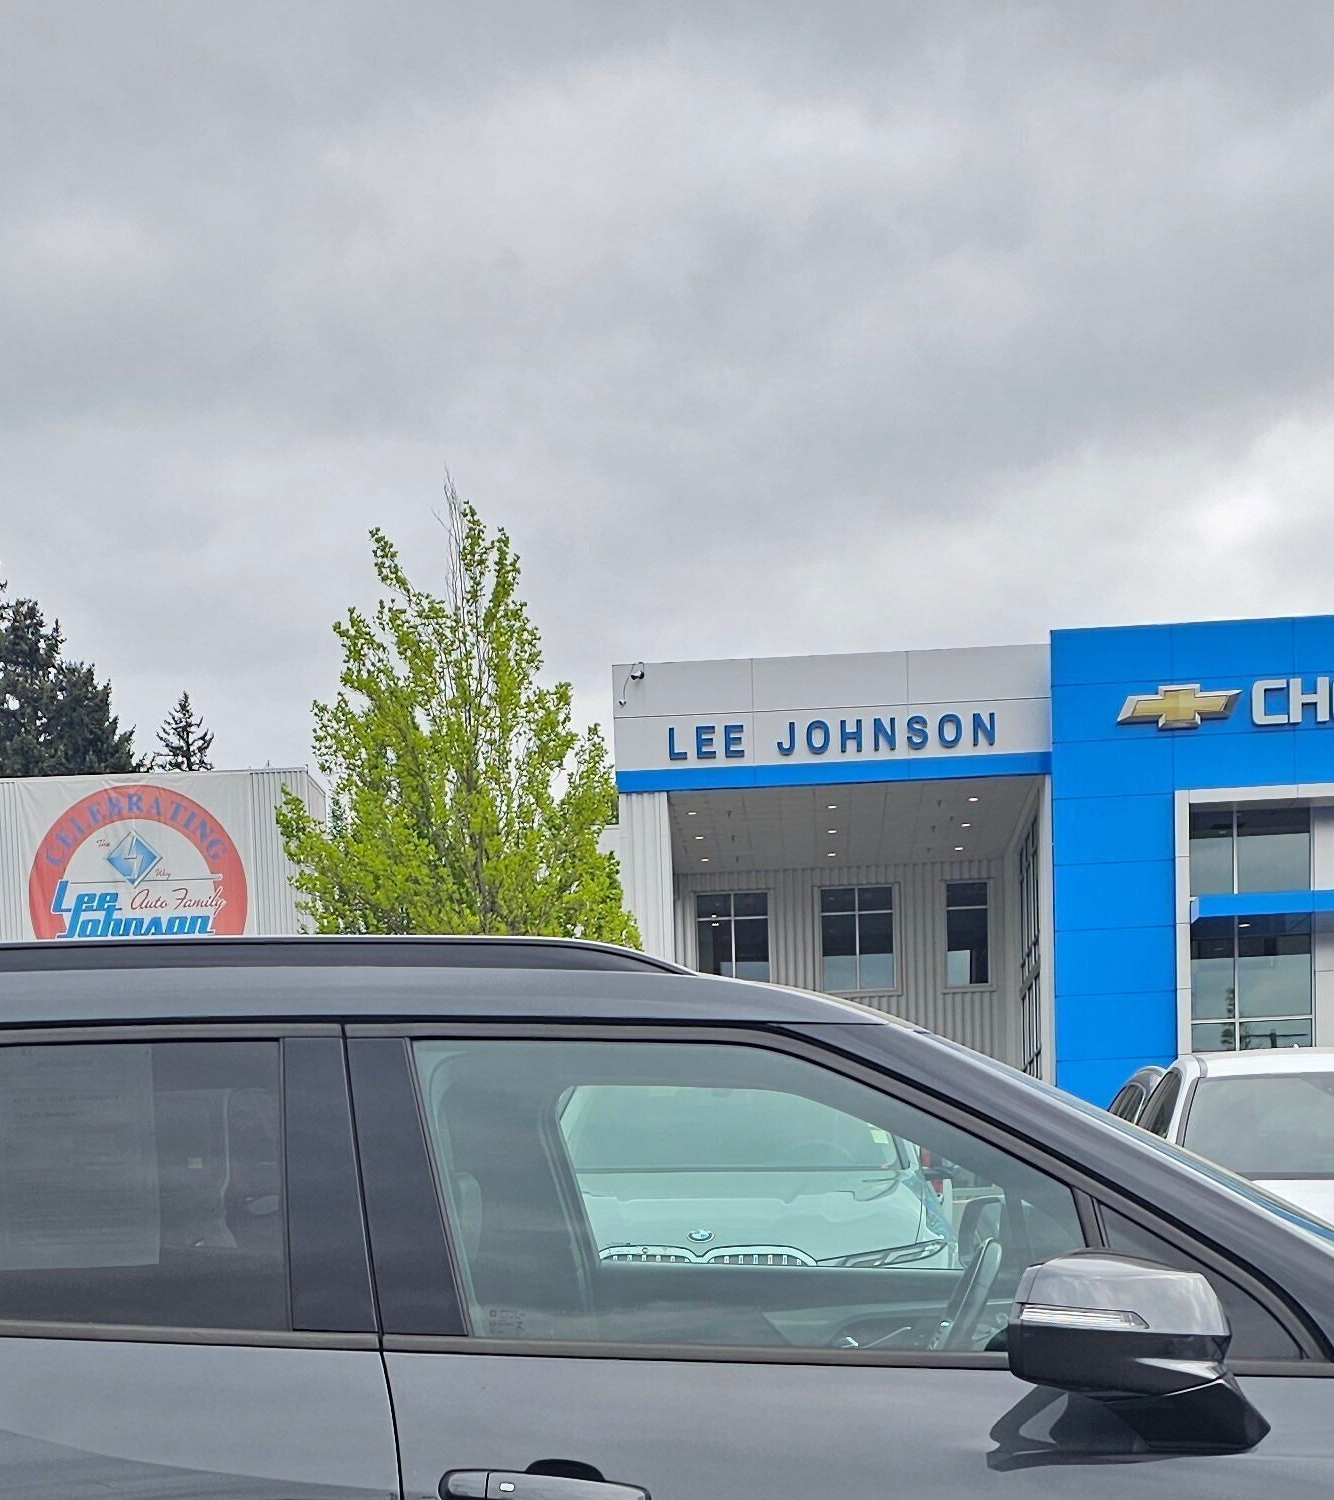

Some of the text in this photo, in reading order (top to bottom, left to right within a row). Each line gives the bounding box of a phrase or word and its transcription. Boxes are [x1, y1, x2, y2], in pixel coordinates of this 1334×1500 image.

[668, 712, 997, 761] LEE JOHNSON
[45, 792, 228, 866] CELEBRATING
[96, 839, 111, 848] The
[52, 880, 227, 916] Lee Auto Family
[55, 908, 216, 939] Johnson
